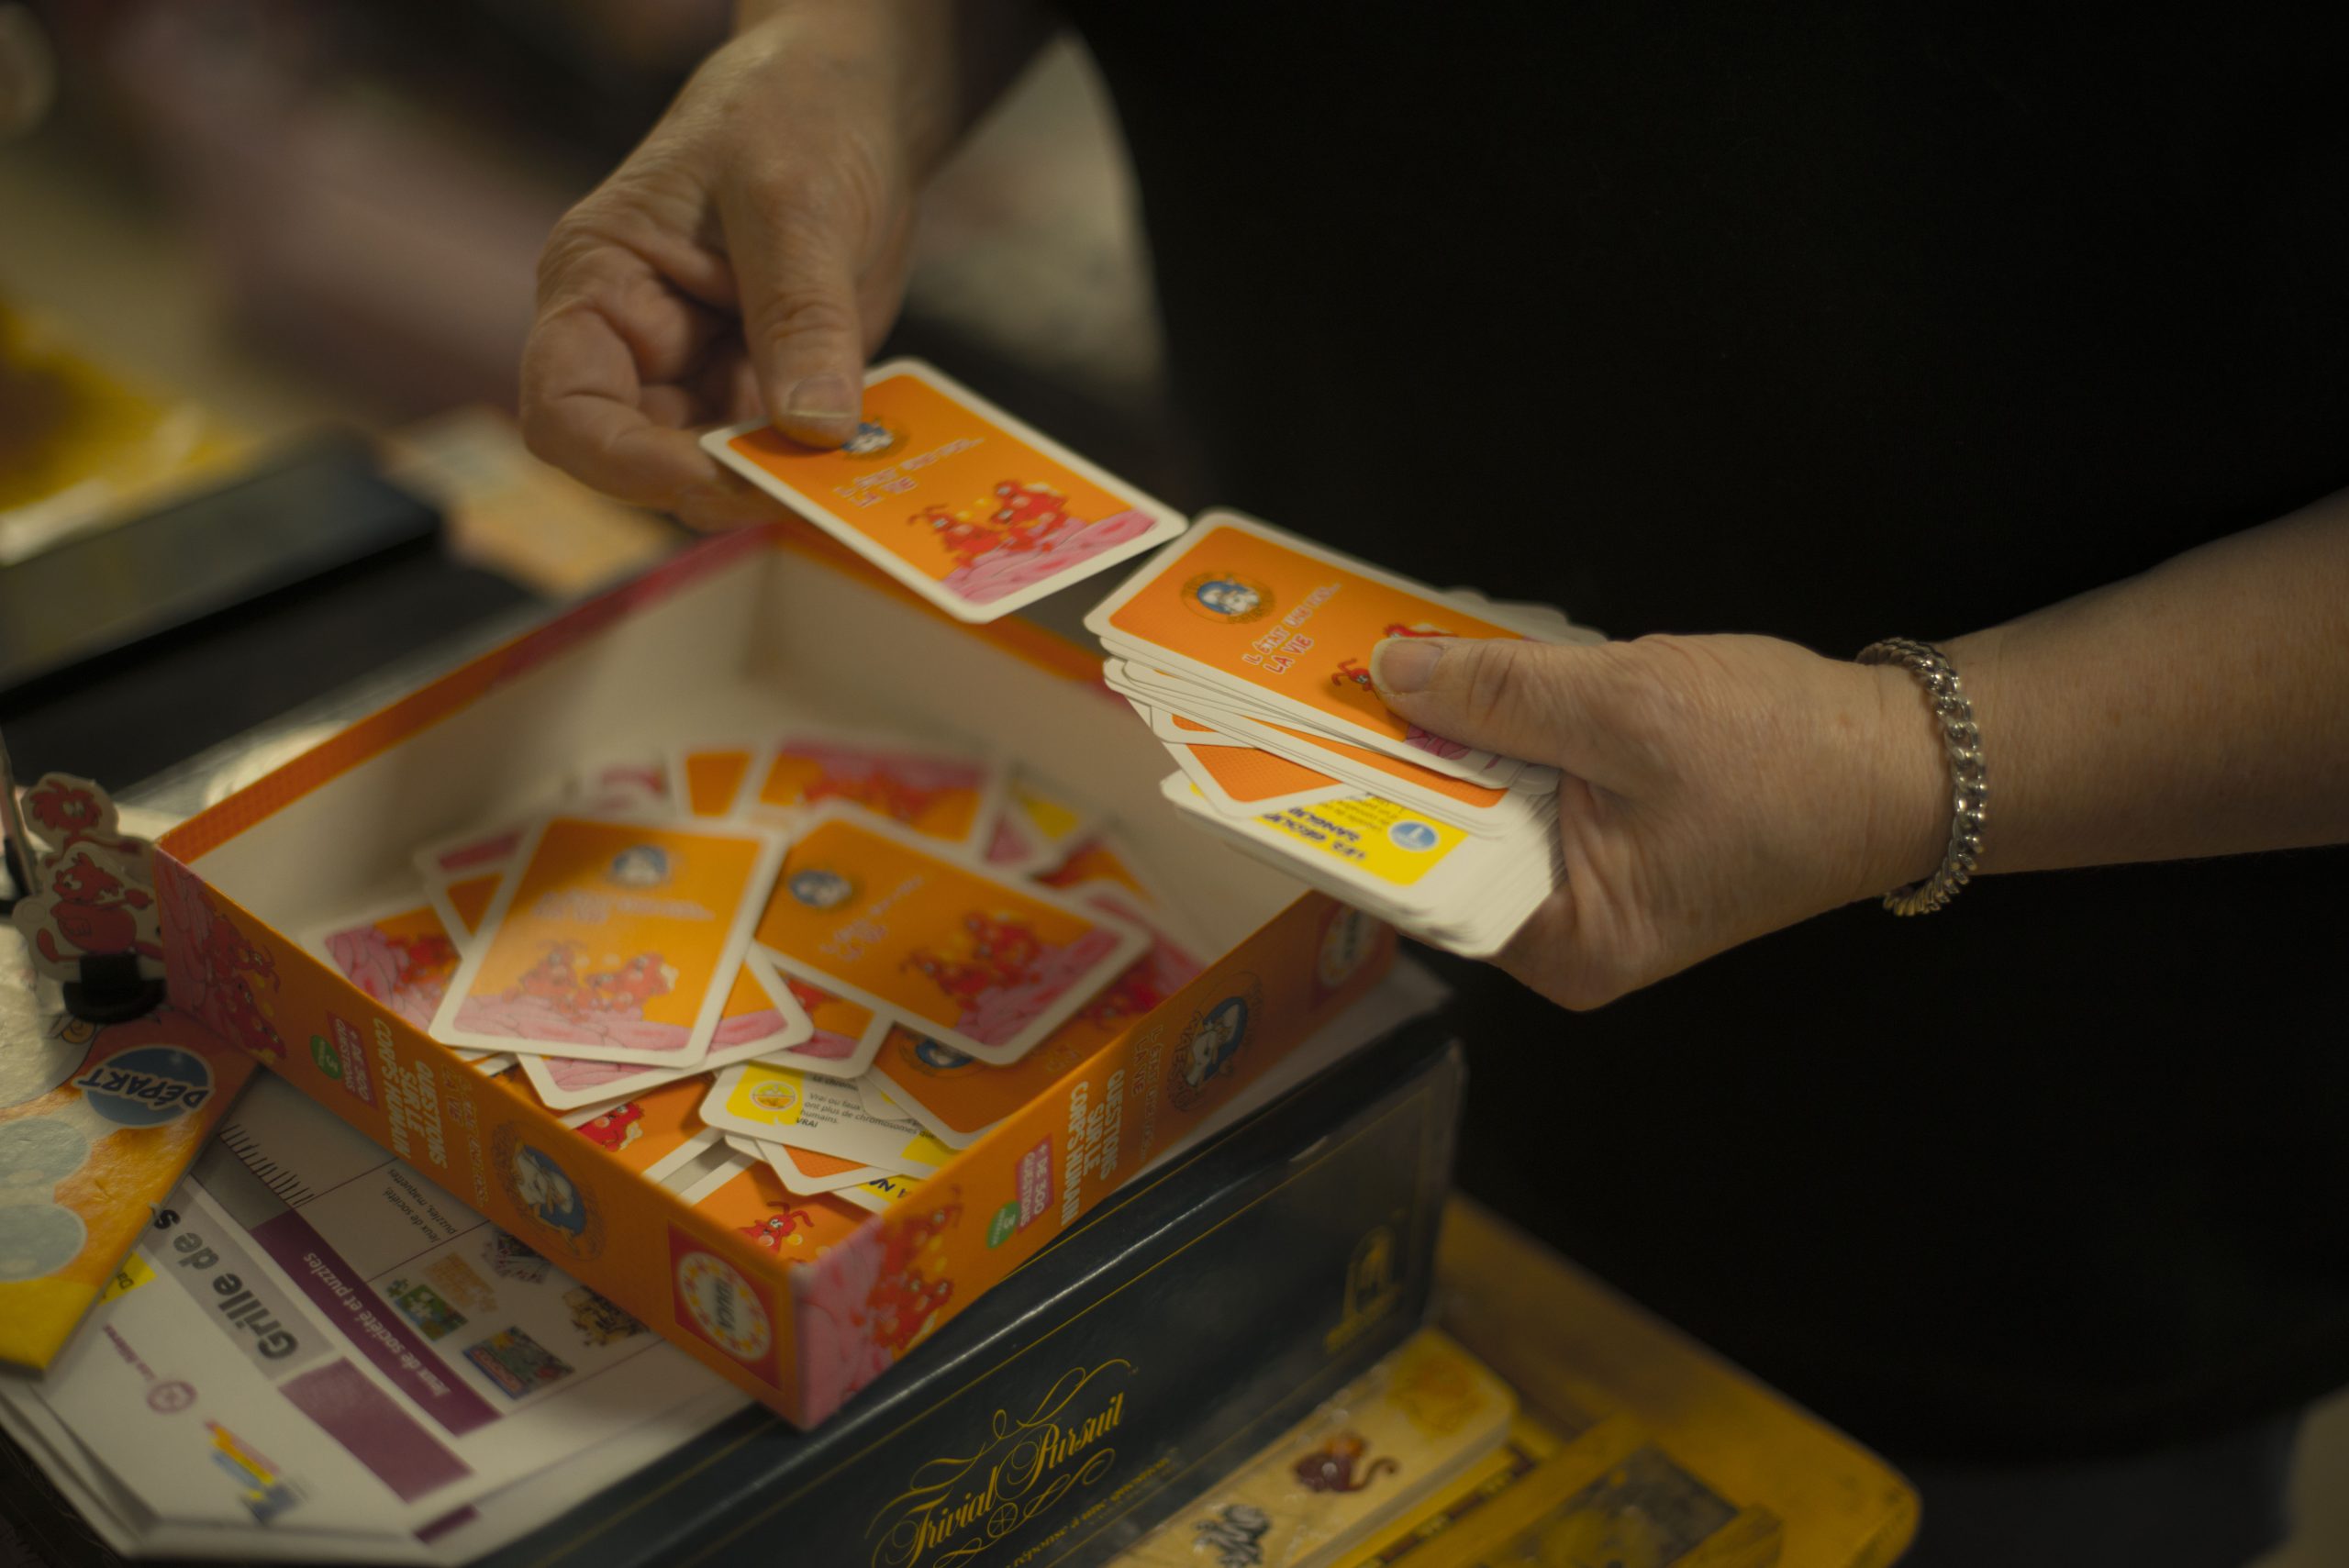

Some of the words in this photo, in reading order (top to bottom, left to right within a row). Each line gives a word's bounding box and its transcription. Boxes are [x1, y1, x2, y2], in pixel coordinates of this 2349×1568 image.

[373, 1018, 399, 1083] CORPS
[77, 1068, 209, 1108] DÉPART
[398, 1067, 420, 1110] SUR
[842, 1100, 861, 1111] faux
[384, 1079, 411, 1160] HUMAIN
[406, 1109, 426, 1138] LE
[415, 1060, 448, 1169] QUESTIONS
[796, 1117, 818, 1129] VRAI
[804, 1102, 820, 1110] ont
[821, 1103, 841, 1115] plus
[841, 1108, 853, 1118] de
[854, 1112, 918, 1135] chromosomes
[1067, 1081, 1089, 1151] CORPS
[1085, 1103, 1104, 1149] SUR
[1101, 1069, 1125, 1181] QUESTIONS
[1036, 1155, 1048, 1178] DE
[1083, 1148, 1101, 1176] LE
[388, 1168, 428, 1207] maquettes
[1019, 1151, 1036, 1228] QUESTIONS
[1033, 1178, 1047, 1215] 300
[1061, 1149, 1084, 1226] HUMAIN
[410, 1214, 424, 1226] de
[173, 1232, 219, 1270] de
[303, 1251, 354, 1297] puzzles
[213, 1273, 298, 1360] Grille
[342, 1295, 363, 1312] et
[355, 1309, 406, 1355] société
[399, 1351, 422, 1372] de
[996, 1392, 1124, 1500] Pursuit
